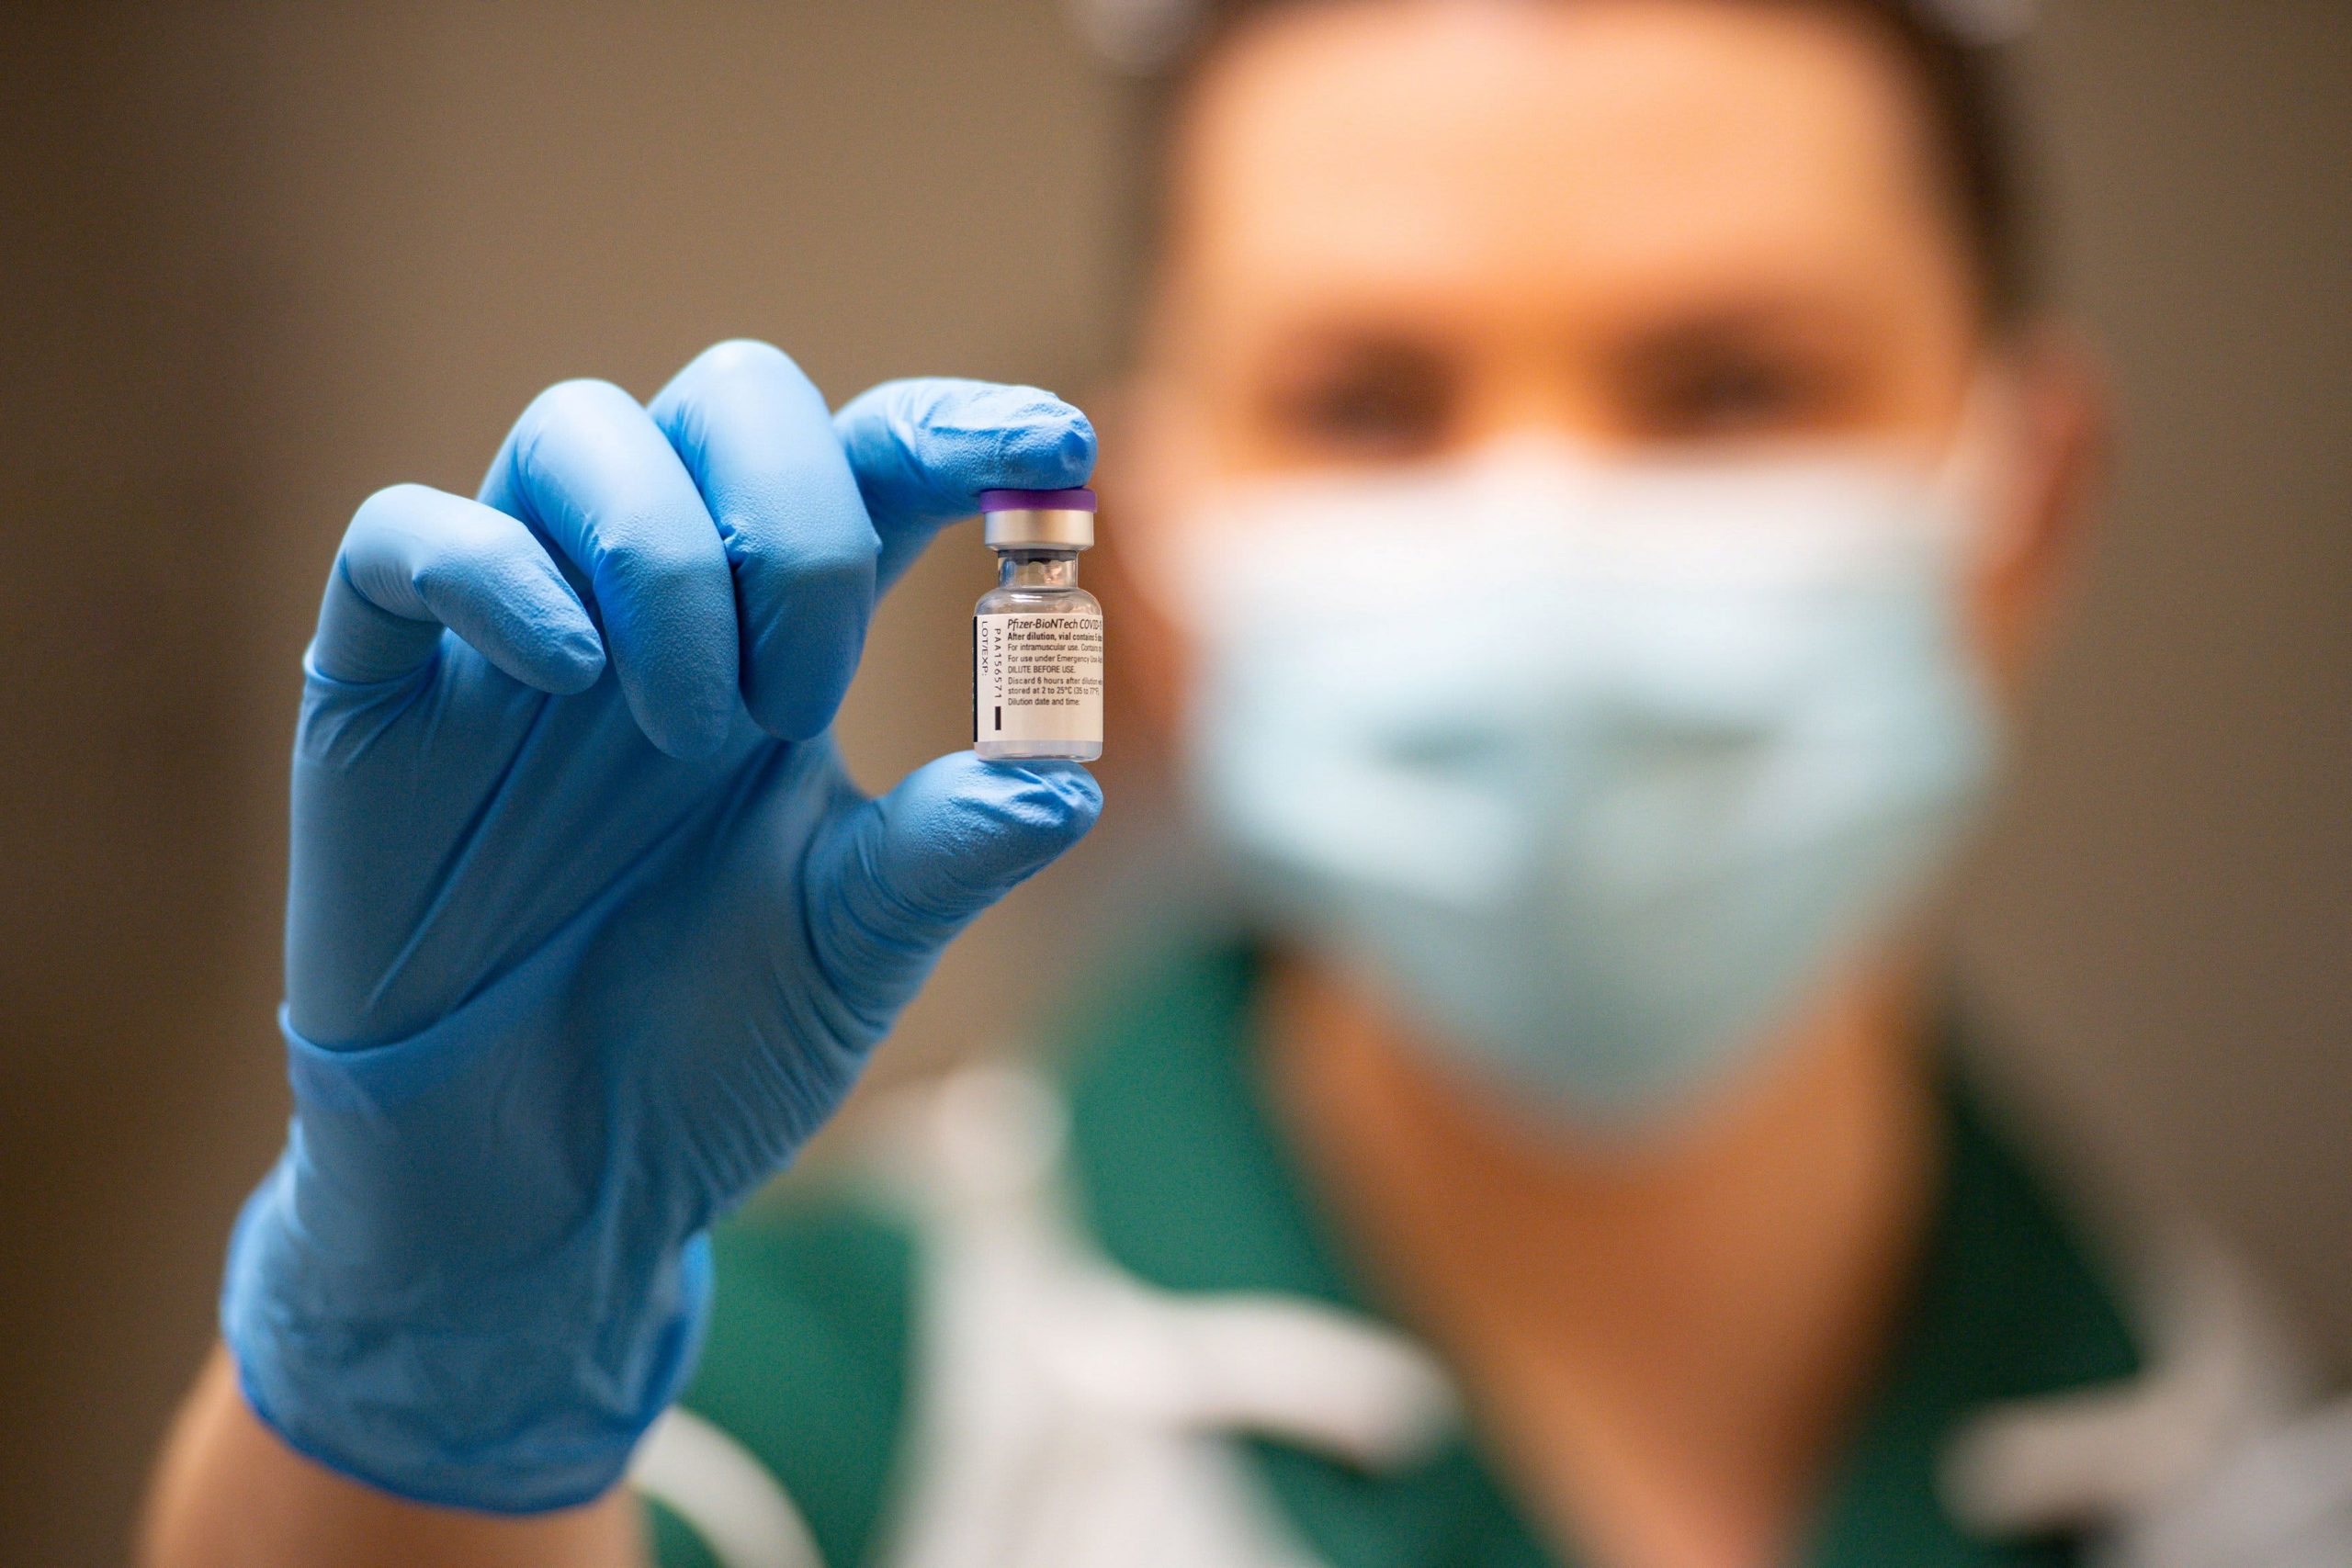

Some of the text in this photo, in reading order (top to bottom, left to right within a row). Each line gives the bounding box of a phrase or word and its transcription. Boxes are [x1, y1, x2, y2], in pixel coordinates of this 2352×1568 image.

[1007, 618, 1078, 631] Pfizer-BioNTech
[1007, 632, 1024, 640] After
[1026, 632, 1057, 641] dilution,
[1058, 632, 1071, 640] vial
[1020, 643, 1066, 651] intramuscular
[994, 628, 1002, 698] PAA156571
[1008, 654, 1018, 662] For
[1035, 654, 1056, 662] under
[1057, 654, 1090, 664] Emergency
[1008, 665, 1032, 673] DILUTE
[1033, 665, 1061, 673] BEFORE
[1008, 676, 1035, 684] Discard
[1037, 676, 1042, 684] 6
[1008, 686, 1031, 694] stored
[1035, 697, 1050, 705] date
